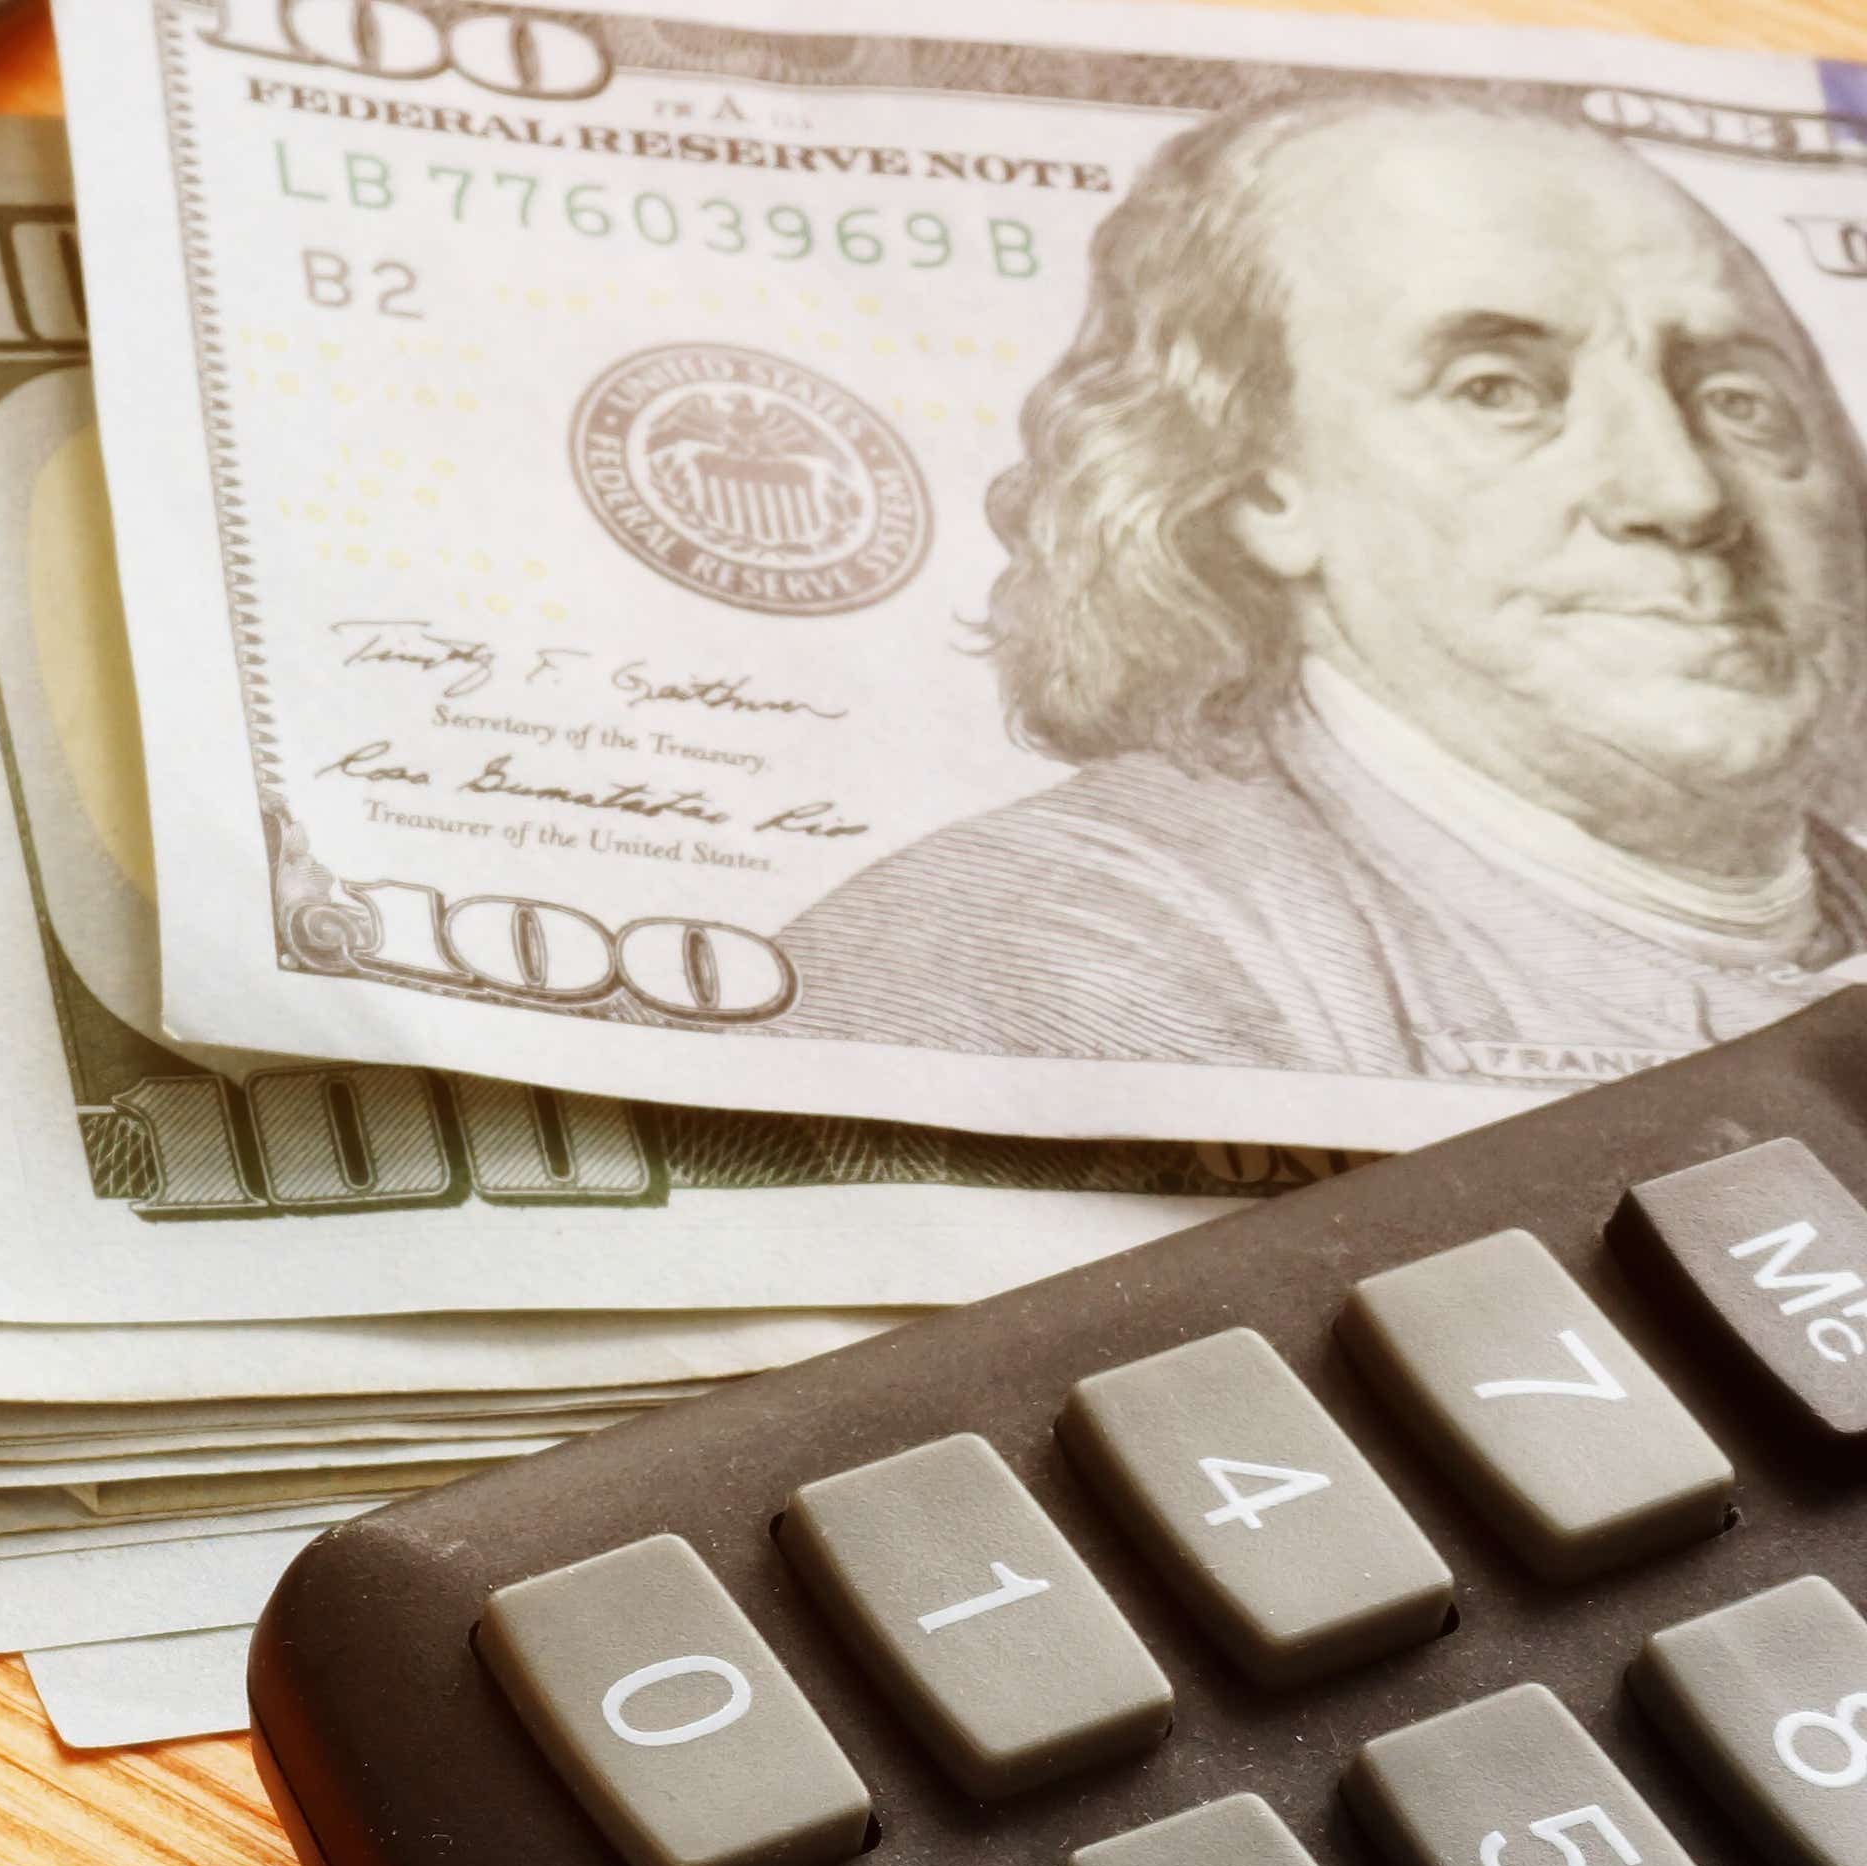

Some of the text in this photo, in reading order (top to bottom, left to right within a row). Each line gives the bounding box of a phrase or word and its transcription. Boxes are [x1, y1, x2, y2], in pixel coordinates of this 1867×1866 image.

[247, 77, 1113, 193] FEDERAL RESERVE NOTE
[302, 247, 424, 320] B2
[432, 702, 556, 746] Secretary
[566, 724, 598, 750] of
[601, 729, 639, 751] the
[363, 798, 494, 838] Treasurer
[502, 820, 534, 850] of
[538, 823, 579, 849] the
[589, 827, 683, 863] United
[339, 878, 801, 1025] 100
[1472, 1329, 1631, 1402] 7
[1198, 1457, 1333, 1530] 4
[917, 1561, 1052, 1635] 1
[601, 1655, 752, 1746] 0
